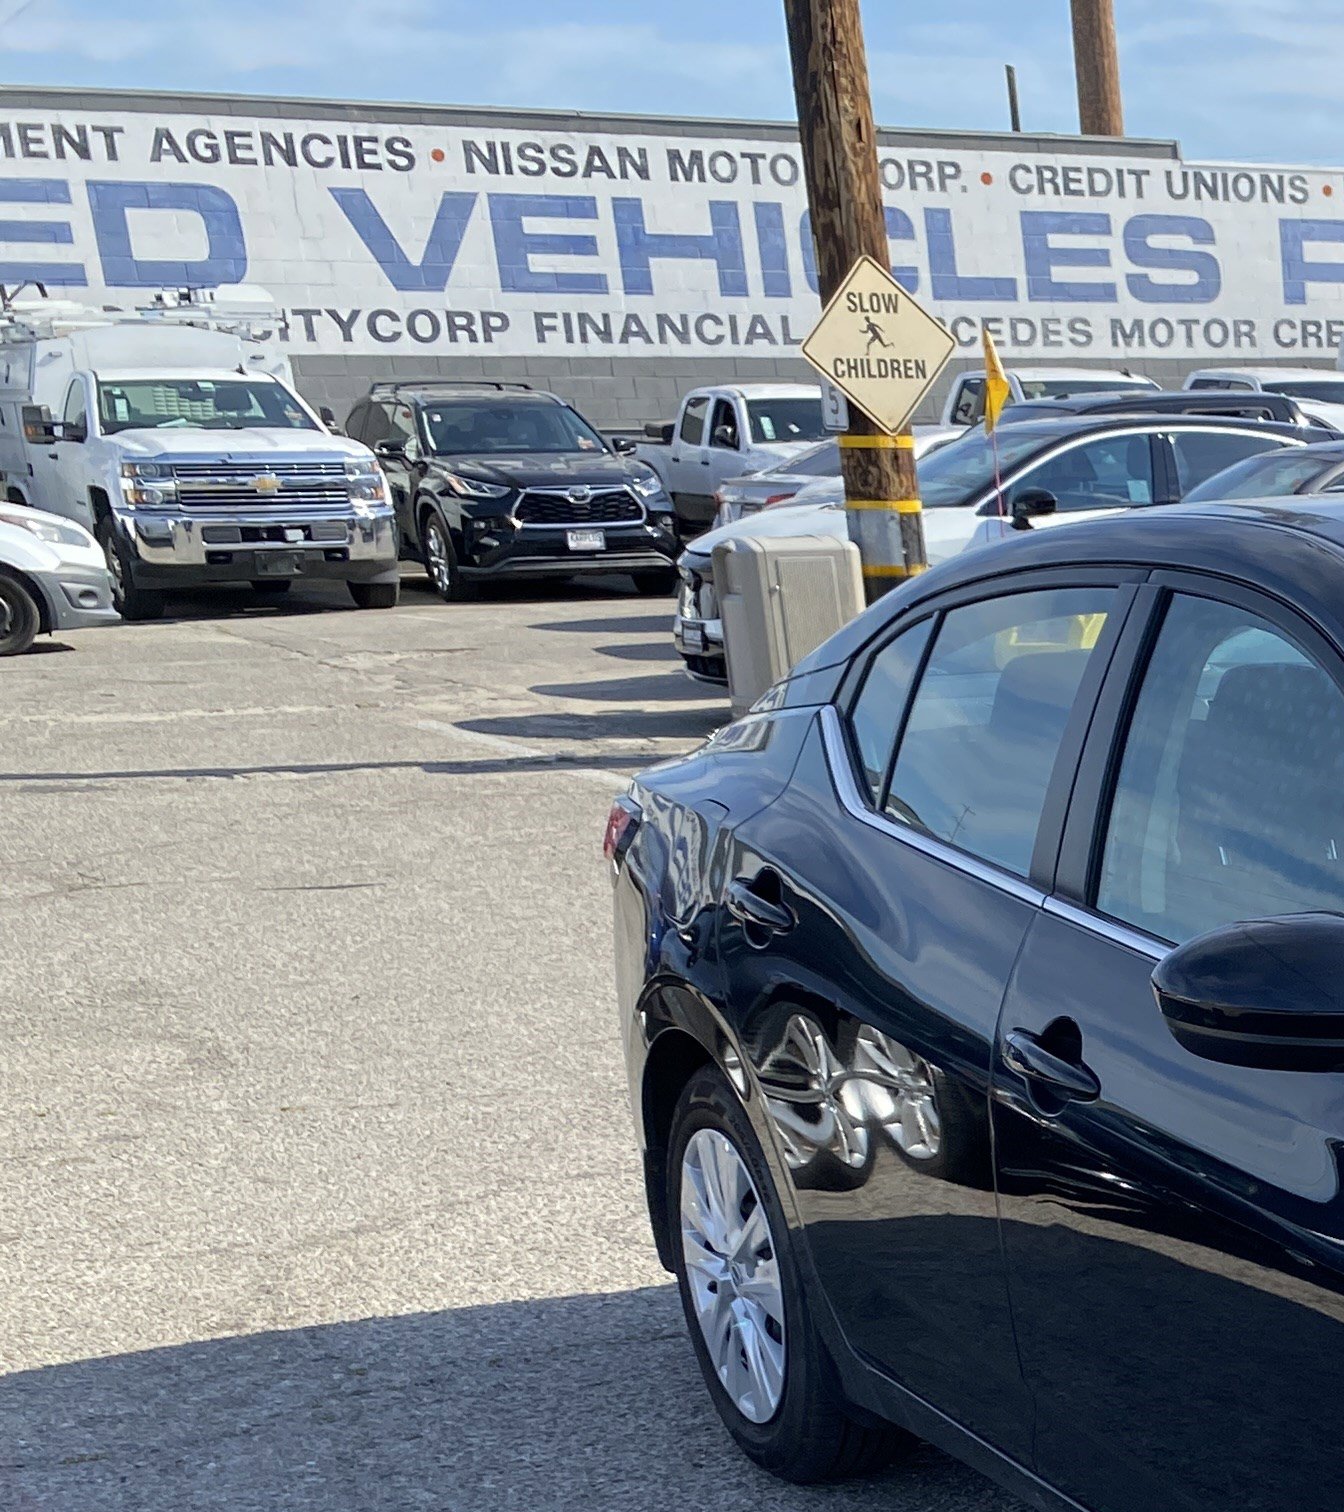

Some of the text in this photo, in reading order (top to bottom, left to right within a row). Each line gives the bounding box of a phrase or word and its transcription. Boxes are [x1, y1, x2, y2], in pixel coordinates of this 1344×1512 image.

[150, 126, 416, 172] AGENCIES
[462, 139, 650, 181] NISSAN
[666, 148, 799, 187] MOTO
[879, 157, 968, 193] ORP.
[1008, 163, 1150, 199] CREDIT
[1165, 169, 1310, 205] UNIONS
[846, 291, 899, 314] SLOW
[533, 311, 803, 346] FINANCIAL
[935, 316, 1093, 347] CEDES
[1109, 317, 1258, 348] MOTOR
[833, 357, 927, 379] CHILDREN
